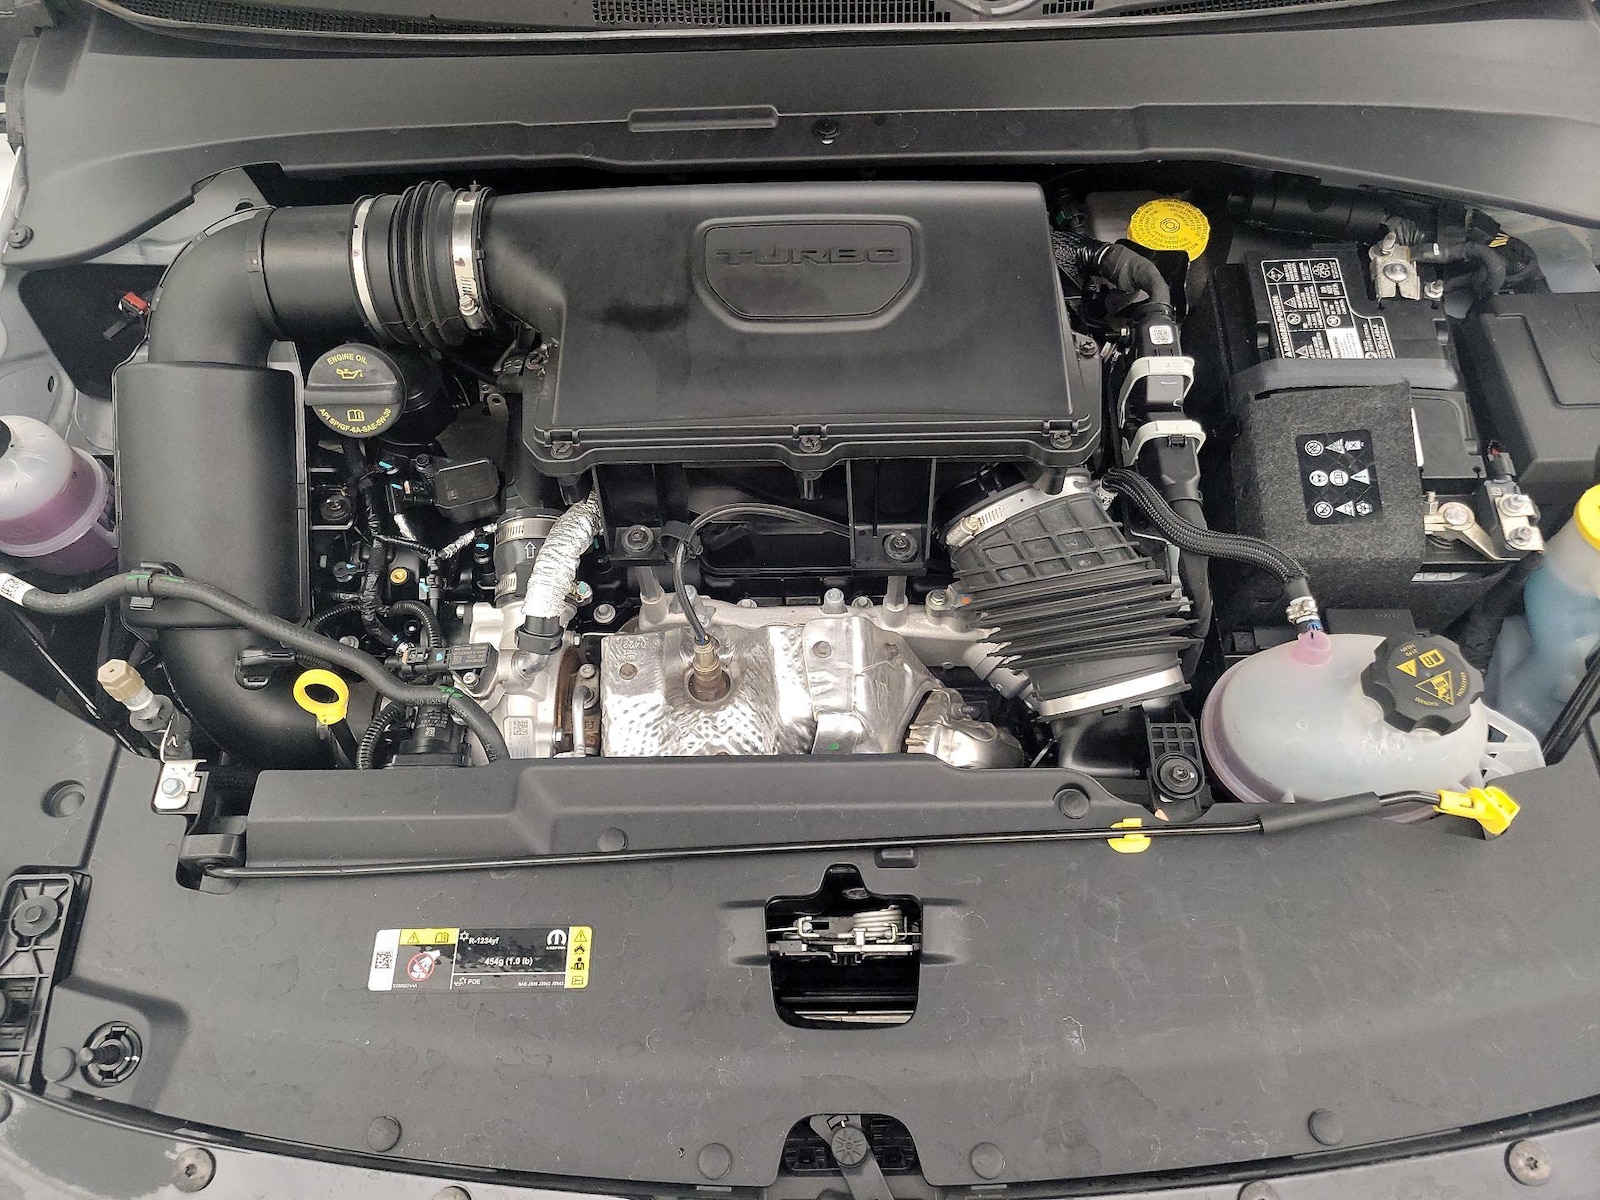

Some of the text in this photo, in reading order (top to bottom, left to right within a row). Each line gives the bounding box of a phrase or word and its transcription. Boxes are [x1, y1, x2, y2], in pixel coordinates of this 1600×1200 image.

[717, 248, 902, 267] TURBO
[1272, 295, 1291, 352] DANGER/POISON
[327, 353, 368, 365] ENGINE OIL
[319, 408, 331, 420] API
[468, 937, 499, 946] R-1234yf
[484, 956, 533, 967] 454g (1.0 lb)
